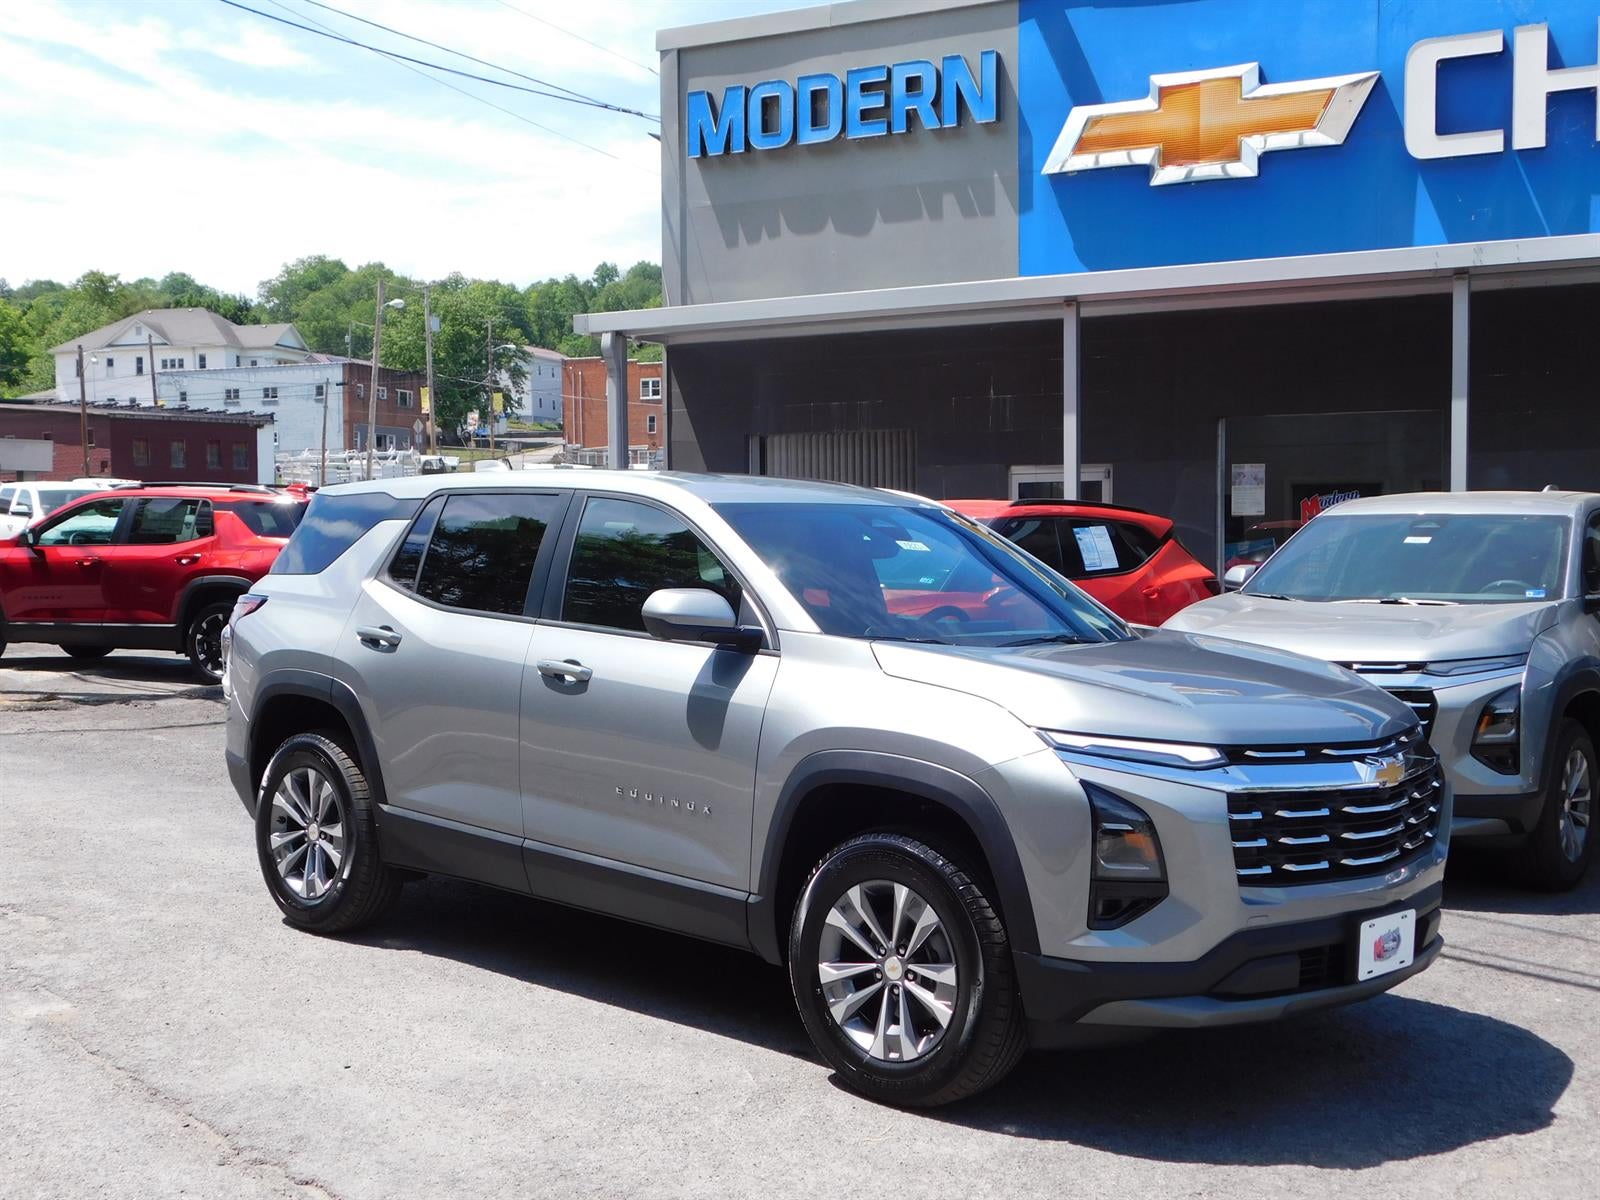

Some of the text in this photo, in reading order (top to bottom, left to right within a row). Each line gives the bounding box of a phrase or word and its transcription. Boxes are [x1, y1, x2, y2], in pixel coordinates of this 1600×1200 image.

[687, 48, 1000, 159] MODERN
[1300, 490, 1360, 525] Modern
[615, 785, 712, 815] EQUINOX
